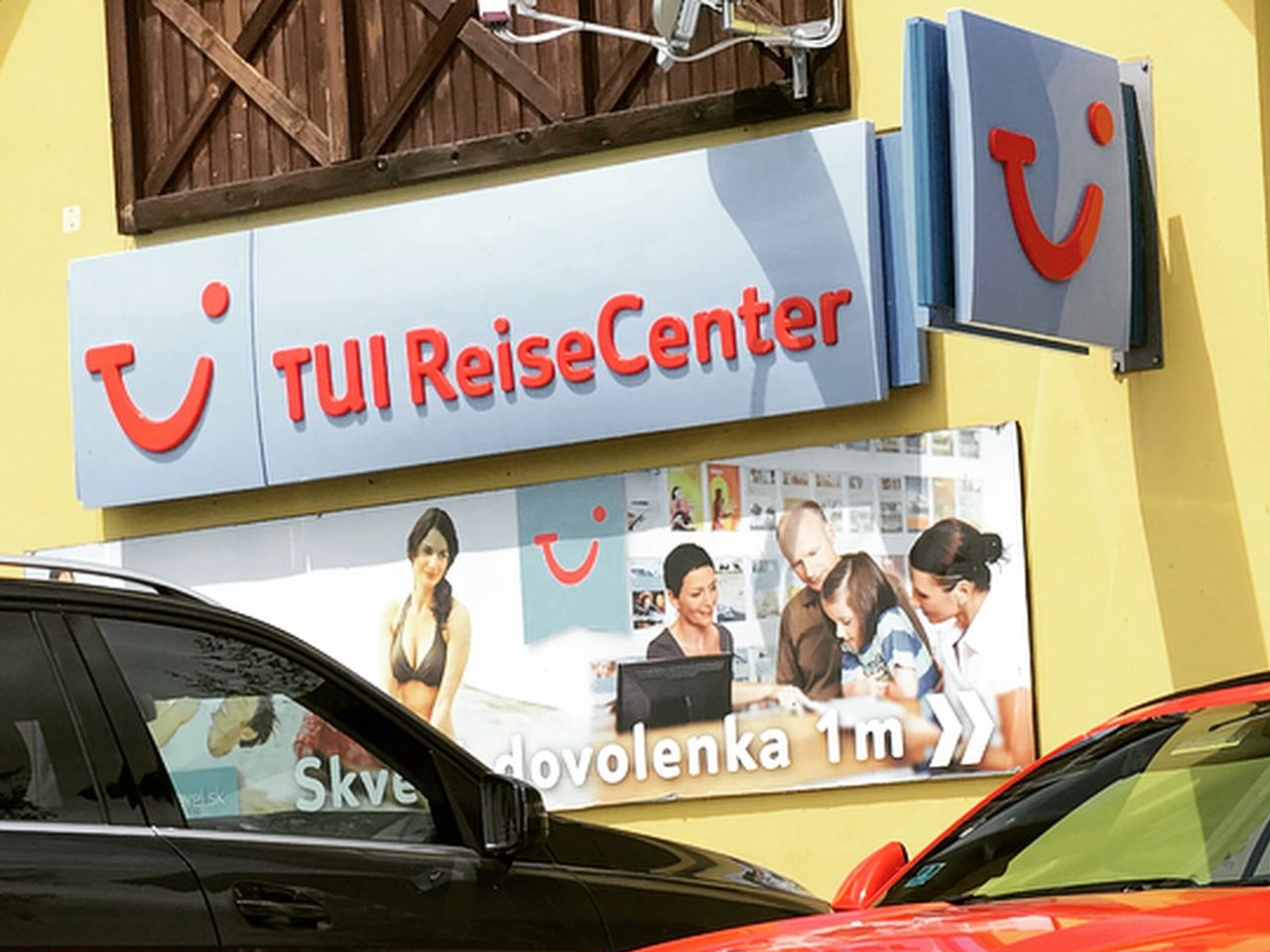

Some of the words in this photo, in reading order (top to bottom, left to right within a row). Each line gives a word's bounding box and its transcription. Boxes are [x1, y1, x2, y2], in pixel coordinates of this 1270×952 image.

[272, 334, 391, 423] TUI
[405, 286, 852, 406] ReiseCenter
[495, 714, 792, 790] dovolenka
[816, 708, 906, 764] 1m
